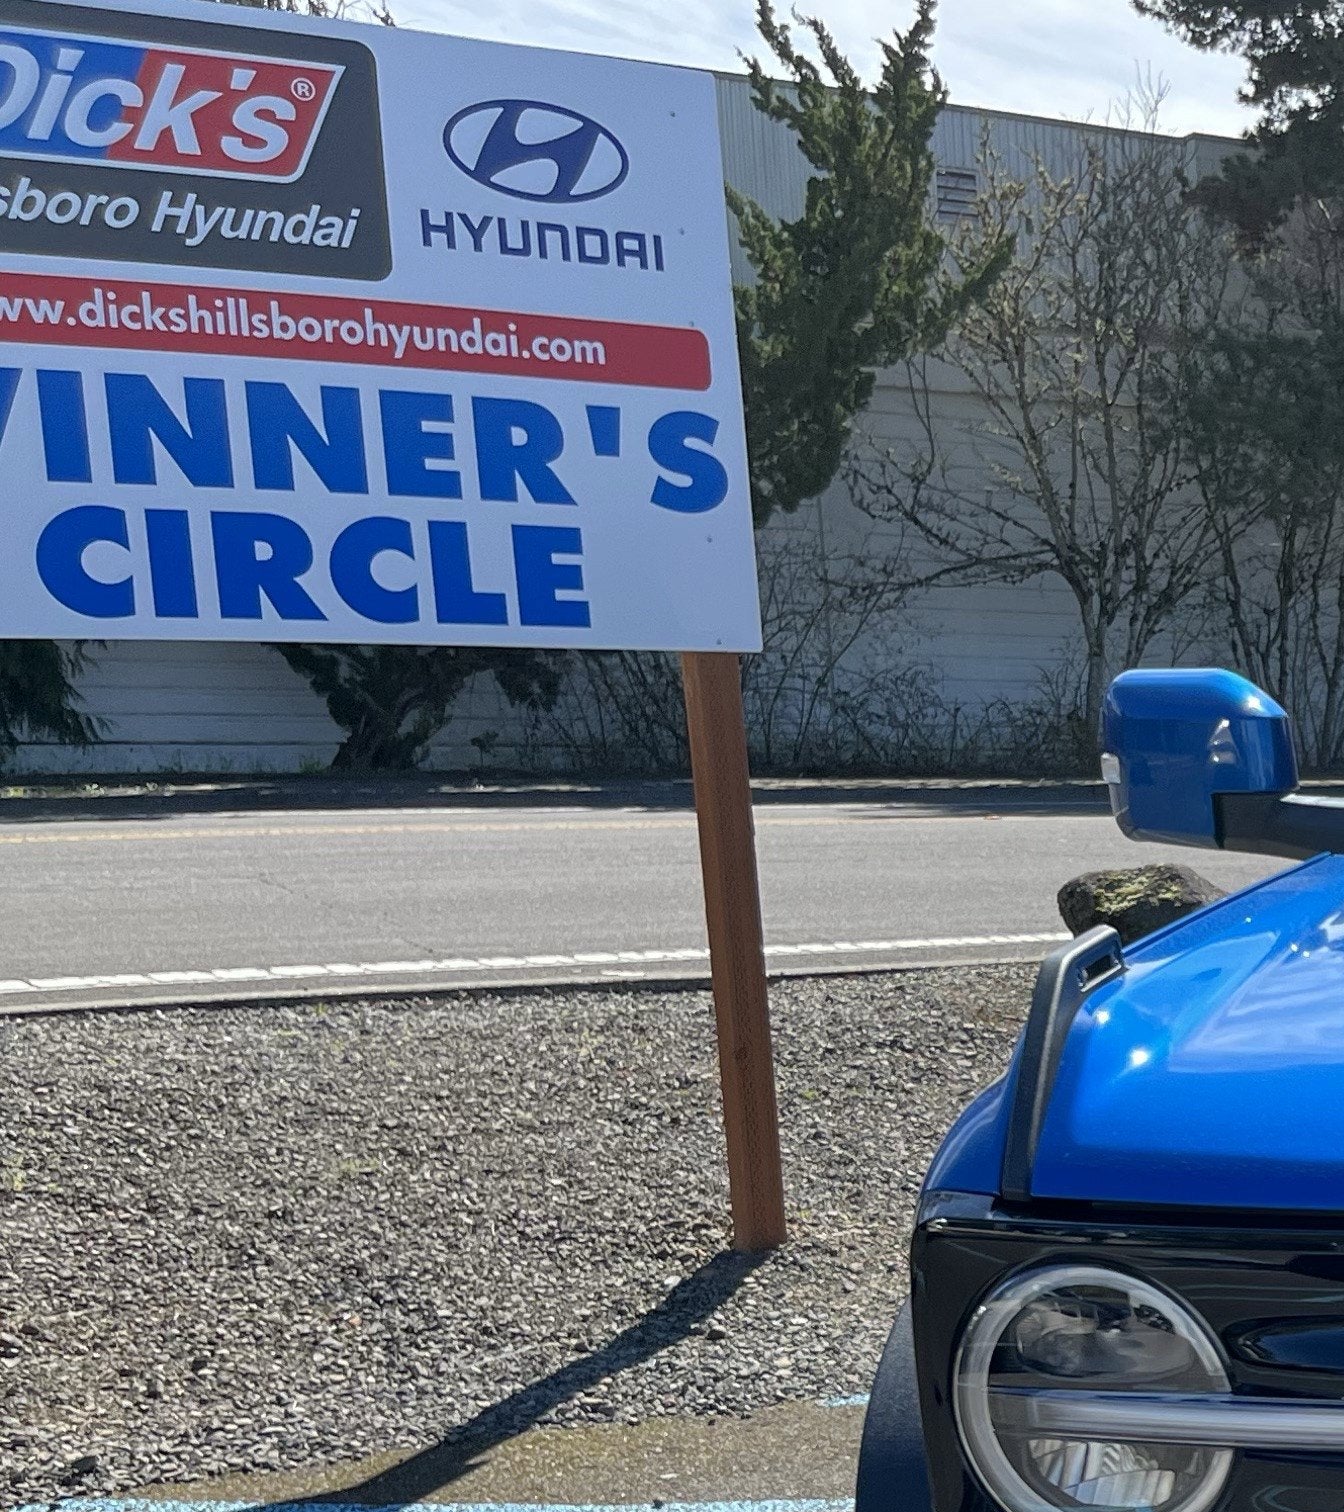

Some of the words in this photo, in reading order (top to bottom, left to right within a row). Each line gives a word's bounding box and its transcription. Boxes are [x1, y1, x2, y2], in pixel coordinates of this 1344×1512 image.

[151, 190, 361, 248] Hyundai
[419, 208, 665, 272] HYUNDAI
[0, 367, 730, 513] INNER'S
[35, 504, 592, 629] CIRCLE
